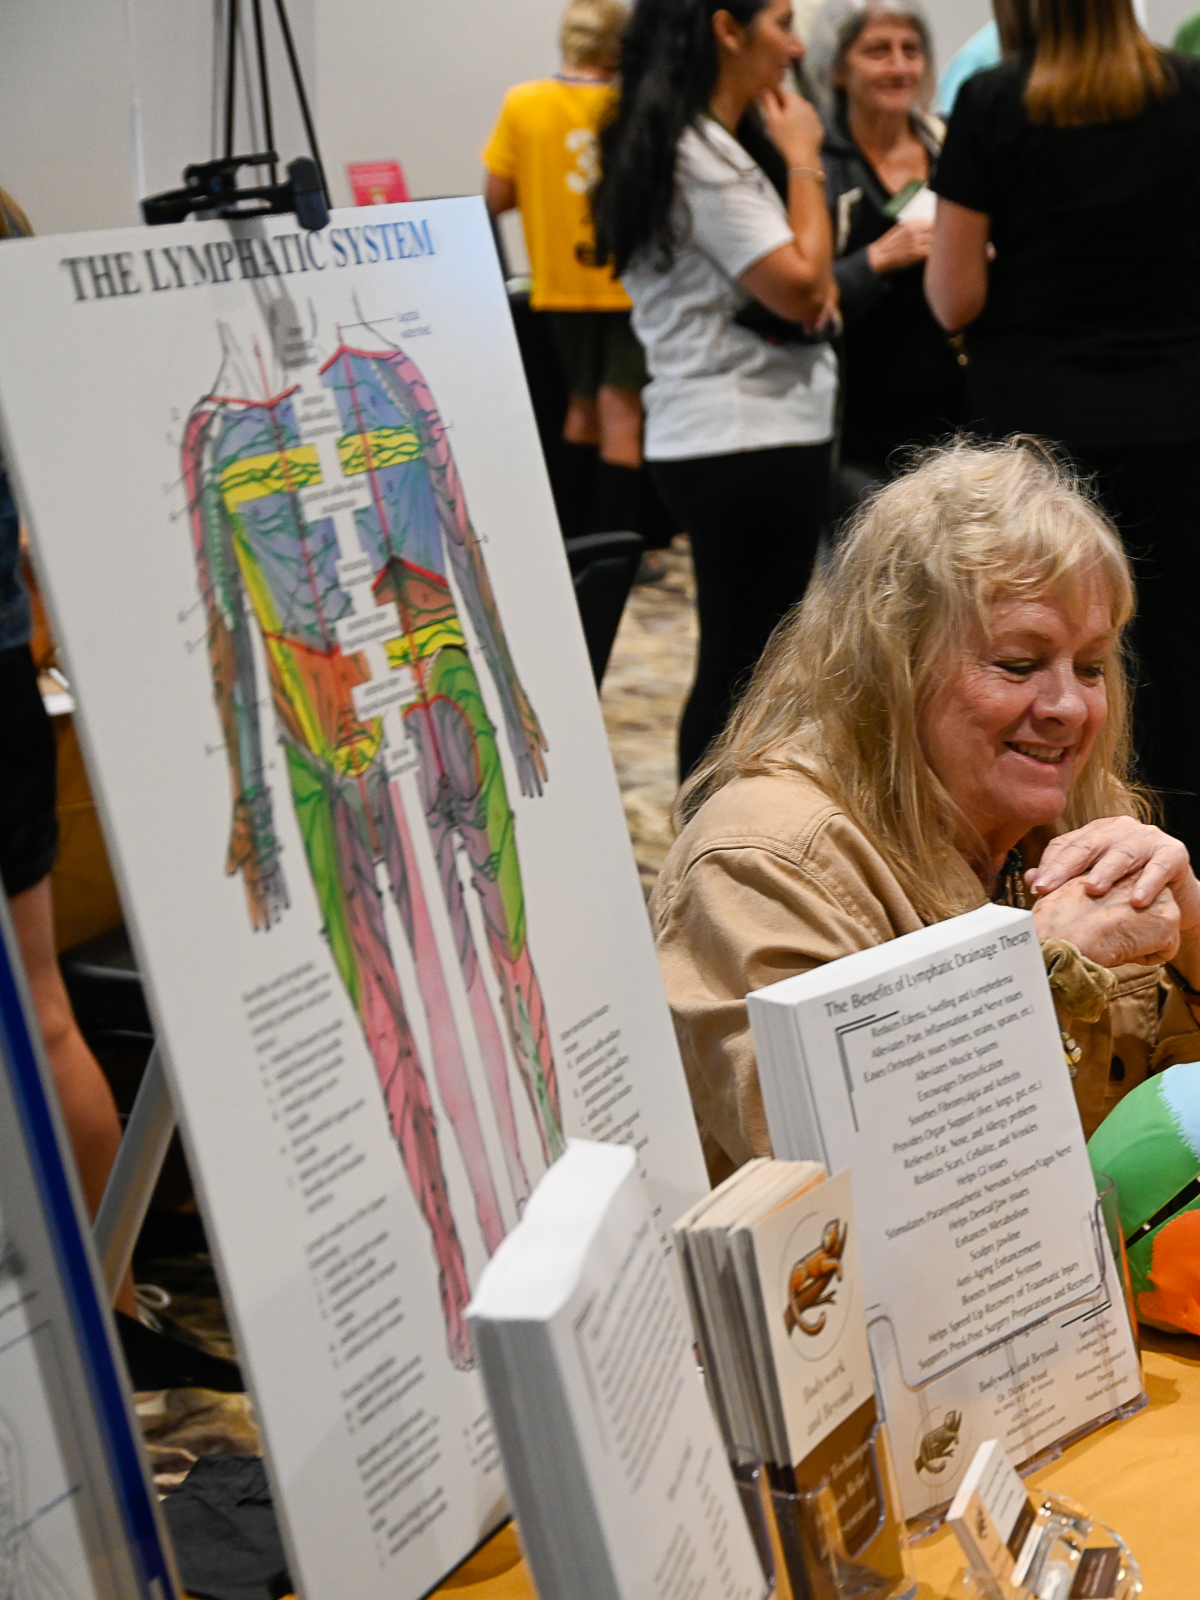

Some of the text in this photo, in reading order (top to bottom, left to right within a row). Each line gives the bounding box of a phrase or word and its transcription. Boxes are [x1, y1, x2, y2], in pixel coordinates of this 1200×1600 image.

[61, 218, 436, 302] THE LYMPHATIC SYSTEM
[824, 1000, 847, 1016] The
[850, 984, 892, 1008] Benefits
[894, 975, 904, 992] of
[905, 961, 953, 986] Lymphatic
[954, 943, 997, 967] Drainage
[957, 991, 970, 1003] and
[982, 1081, 994, 1094] and
[923, 1124, 946, 1139] Organ
[946, 1111, 974, 1129] Support
[971, 1126, 984, 1140] and
[997, 1134, 1010, 1148] and
[994, 1241, 1040, 1268] Enhancement
[961, 1260, 1042, 1305] Boosts Immune System
[927, 1328, 947, 1342] Helps
[948, 1314, 971, 1332] Speed
[971, 1309, 984, 1320] Up
[984, 1293, 1014, 1313] Recovery
[1015, 1285, 1024, 1297] of
[1025, 1271, 1059, 1292] Traumatic
[984, 1316, 1009, 1334] Surgery
[1011, 1295, 1051, 1318] Preparation
[1053, 1286, 1065, 1300] and
[1066, 1273, 1094, 1291] Recovery
